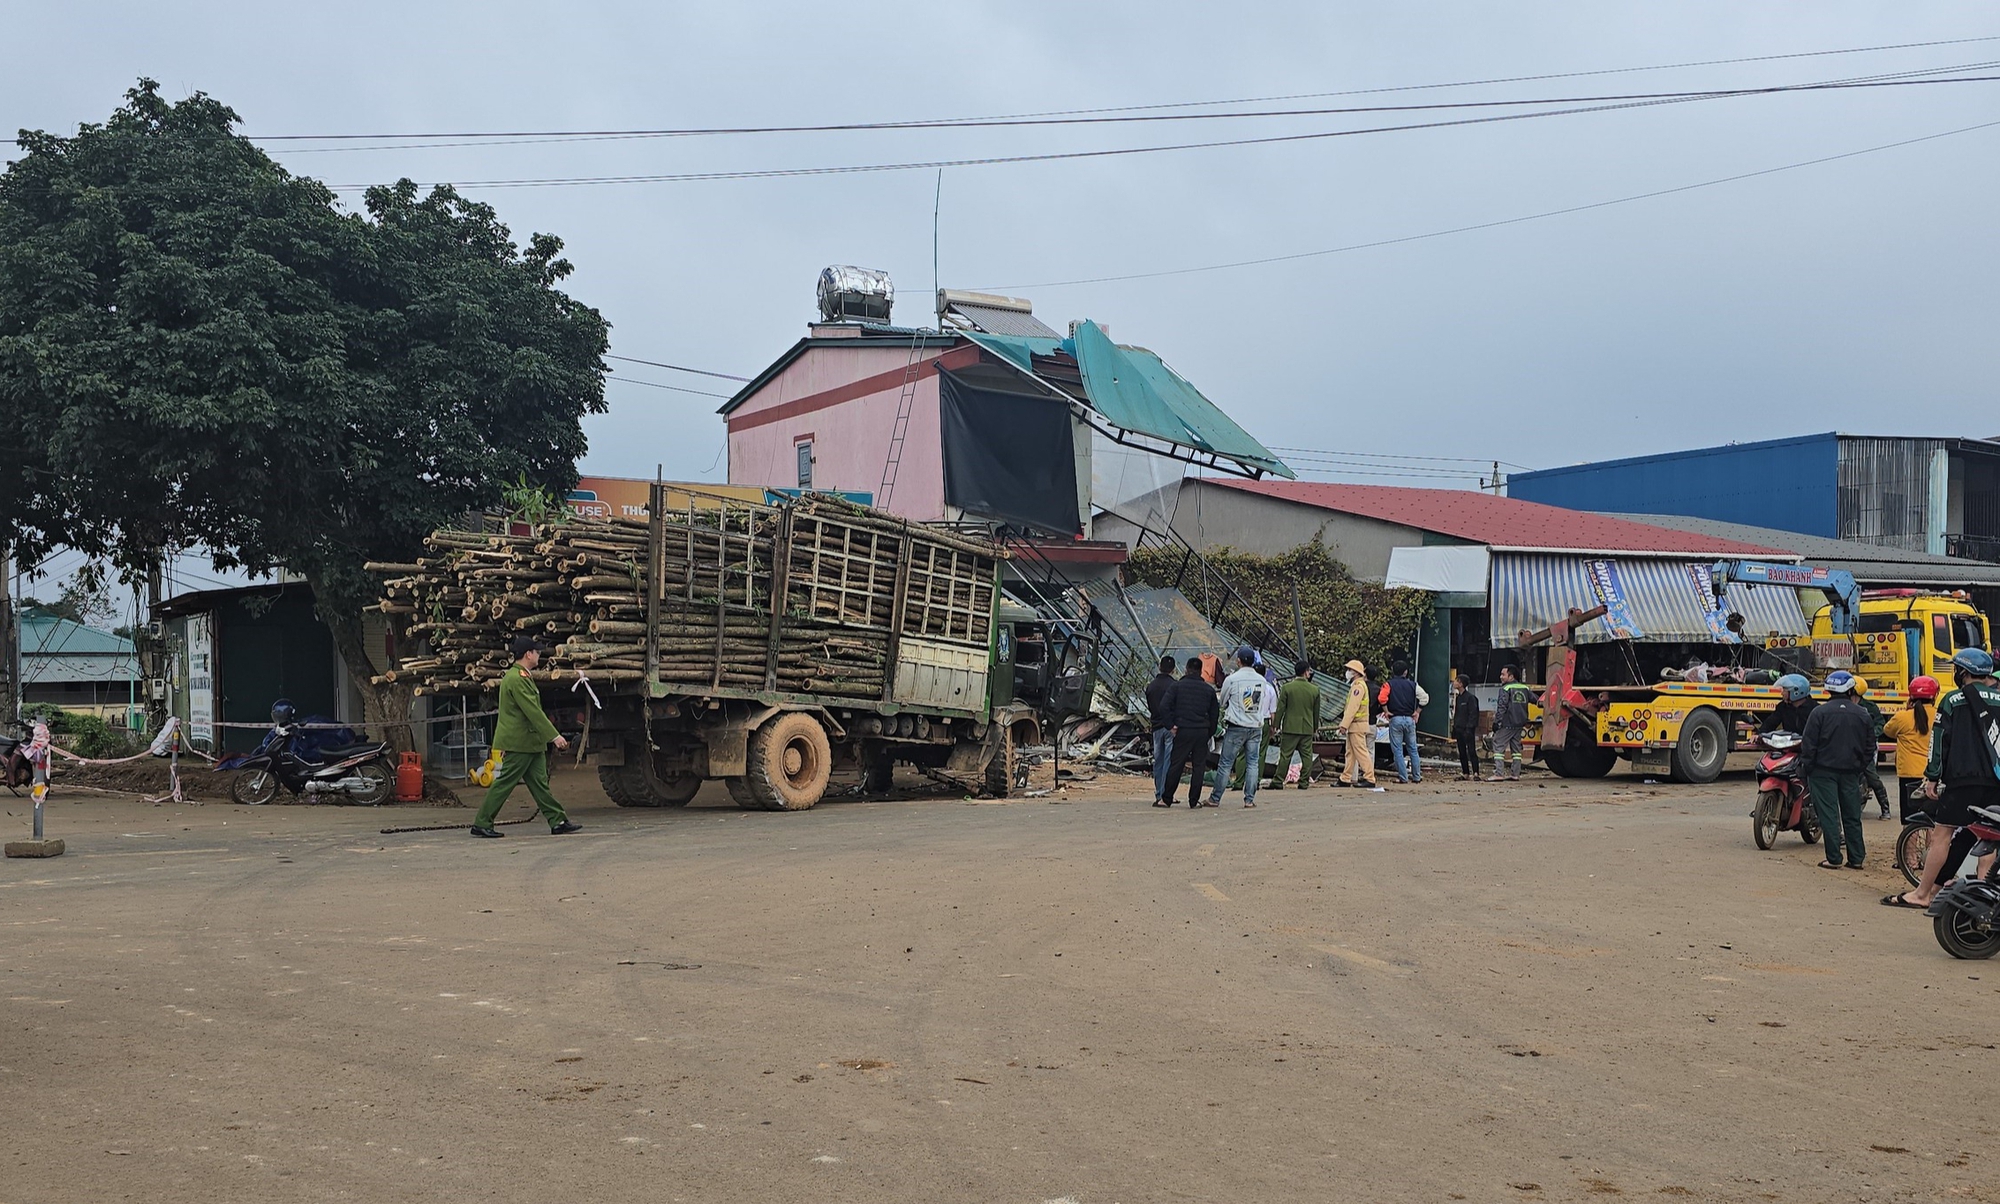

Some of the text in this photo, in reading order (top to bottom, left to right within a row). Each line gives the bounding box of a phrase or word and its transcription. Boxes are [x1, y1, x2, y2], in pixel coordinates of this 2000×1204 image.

[570, 505, 603, 516] USE
[1594, 562, 1618, 602] OVITAN
[1785, 567, 1812, 584] KHÁNH
